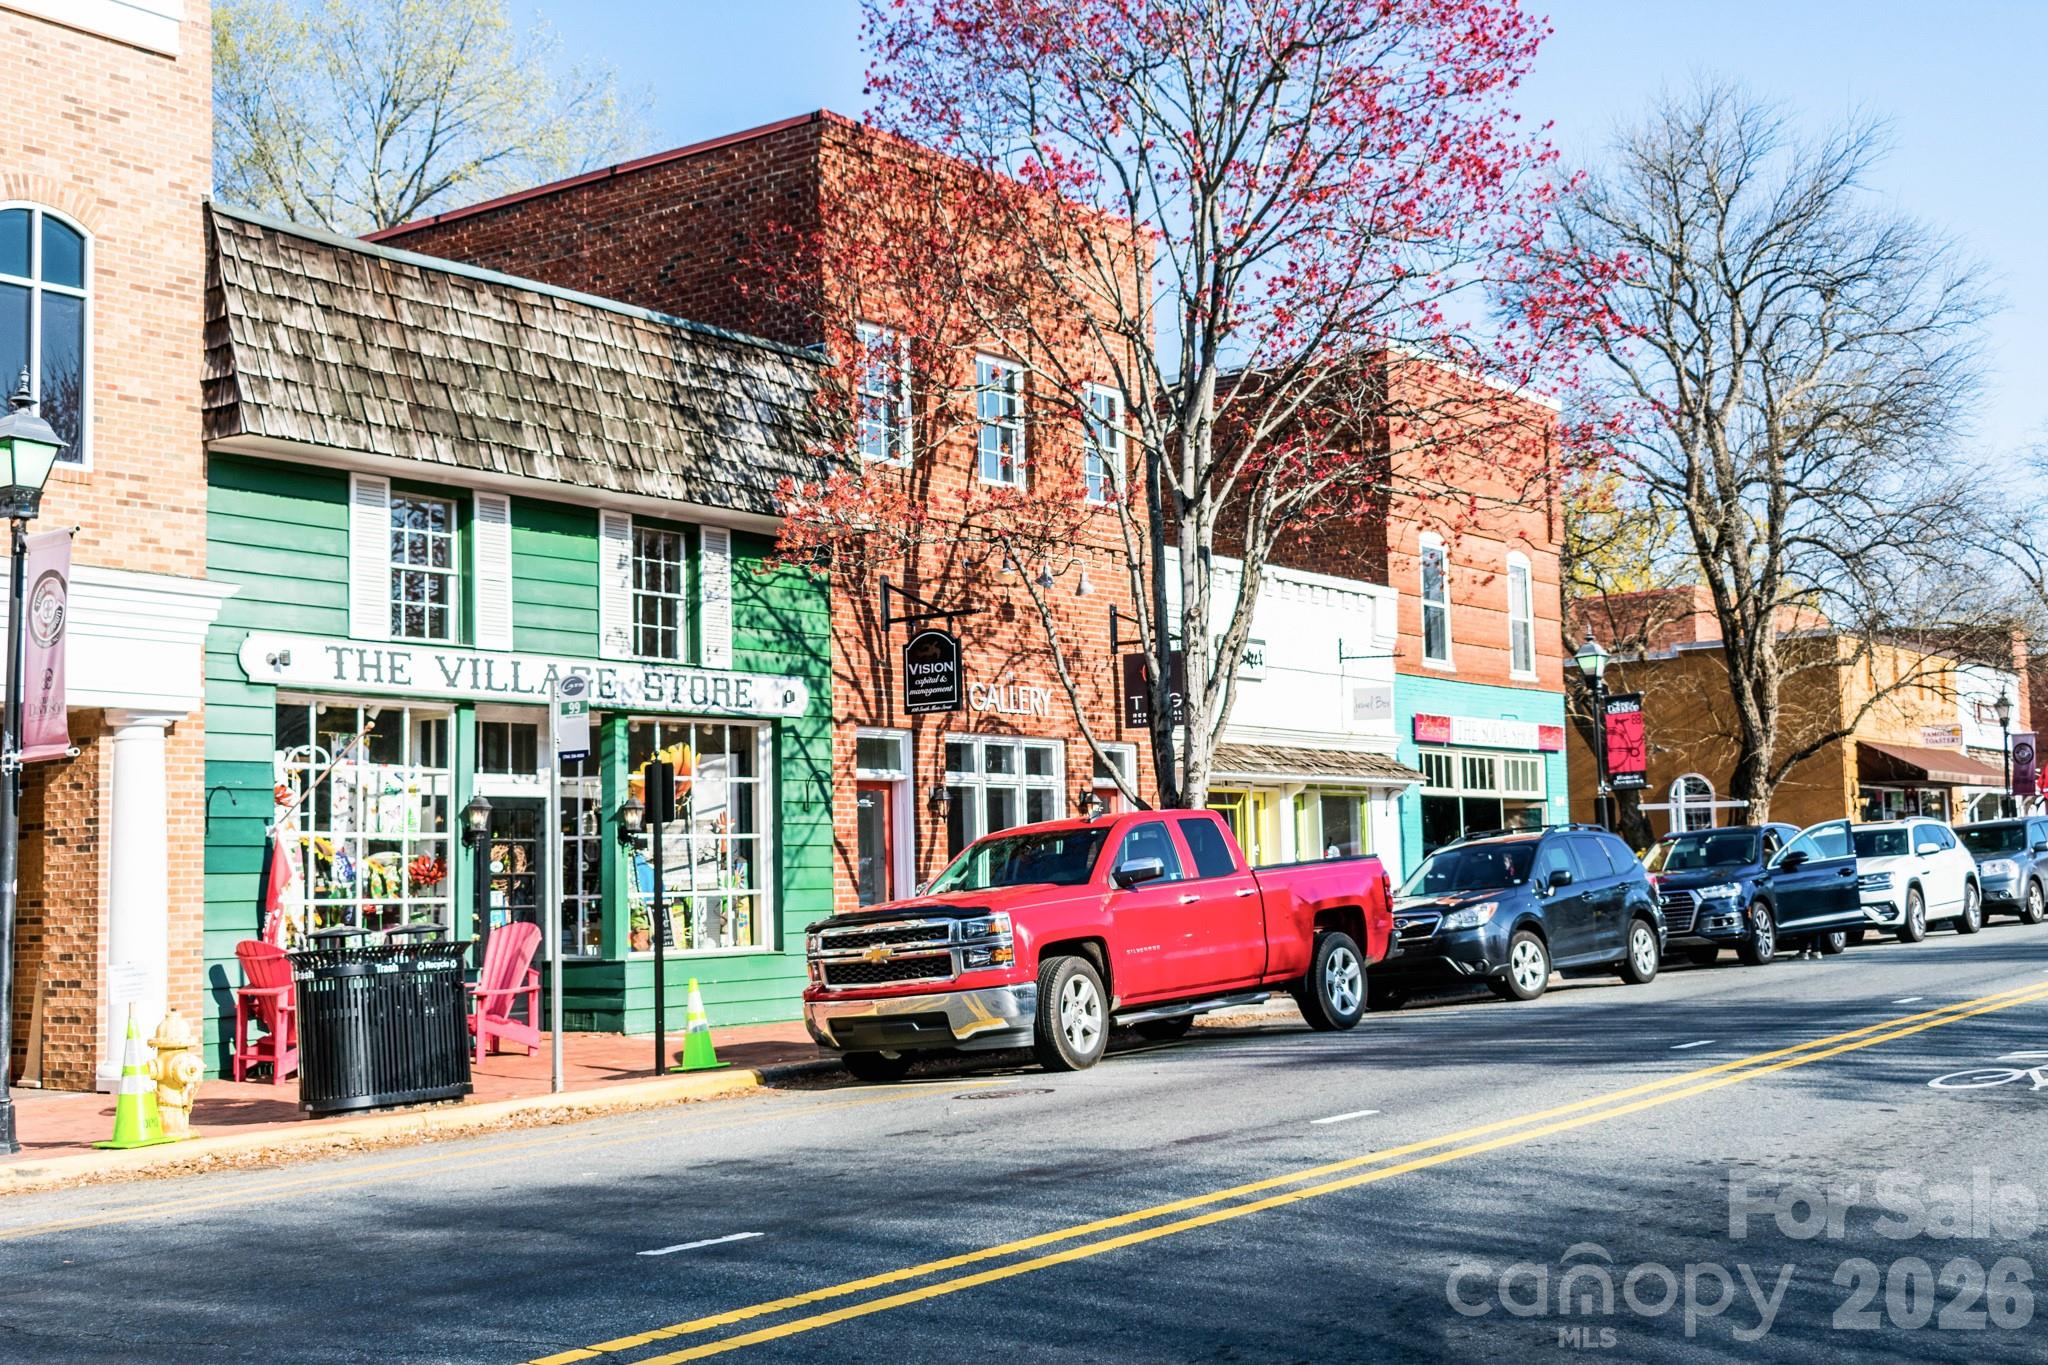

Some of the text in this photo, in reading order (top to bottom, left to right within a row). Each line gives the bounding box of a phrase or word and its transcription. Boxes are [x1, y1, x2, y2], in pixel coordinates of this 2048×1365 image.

[908, 661, 954, 675] VISION
[325, 645, 412, 686] THE
[643, 672, 753, 709] STORE
[914, 674, 948, 687] capital &
[909, 685, 954, 697] management
[968, 681, 1053, 716] GALLERY
[568, 702, 581, 714] 99
[375, 963, 399, 974] Trash
[424, 960, 450, 970] Recycle
